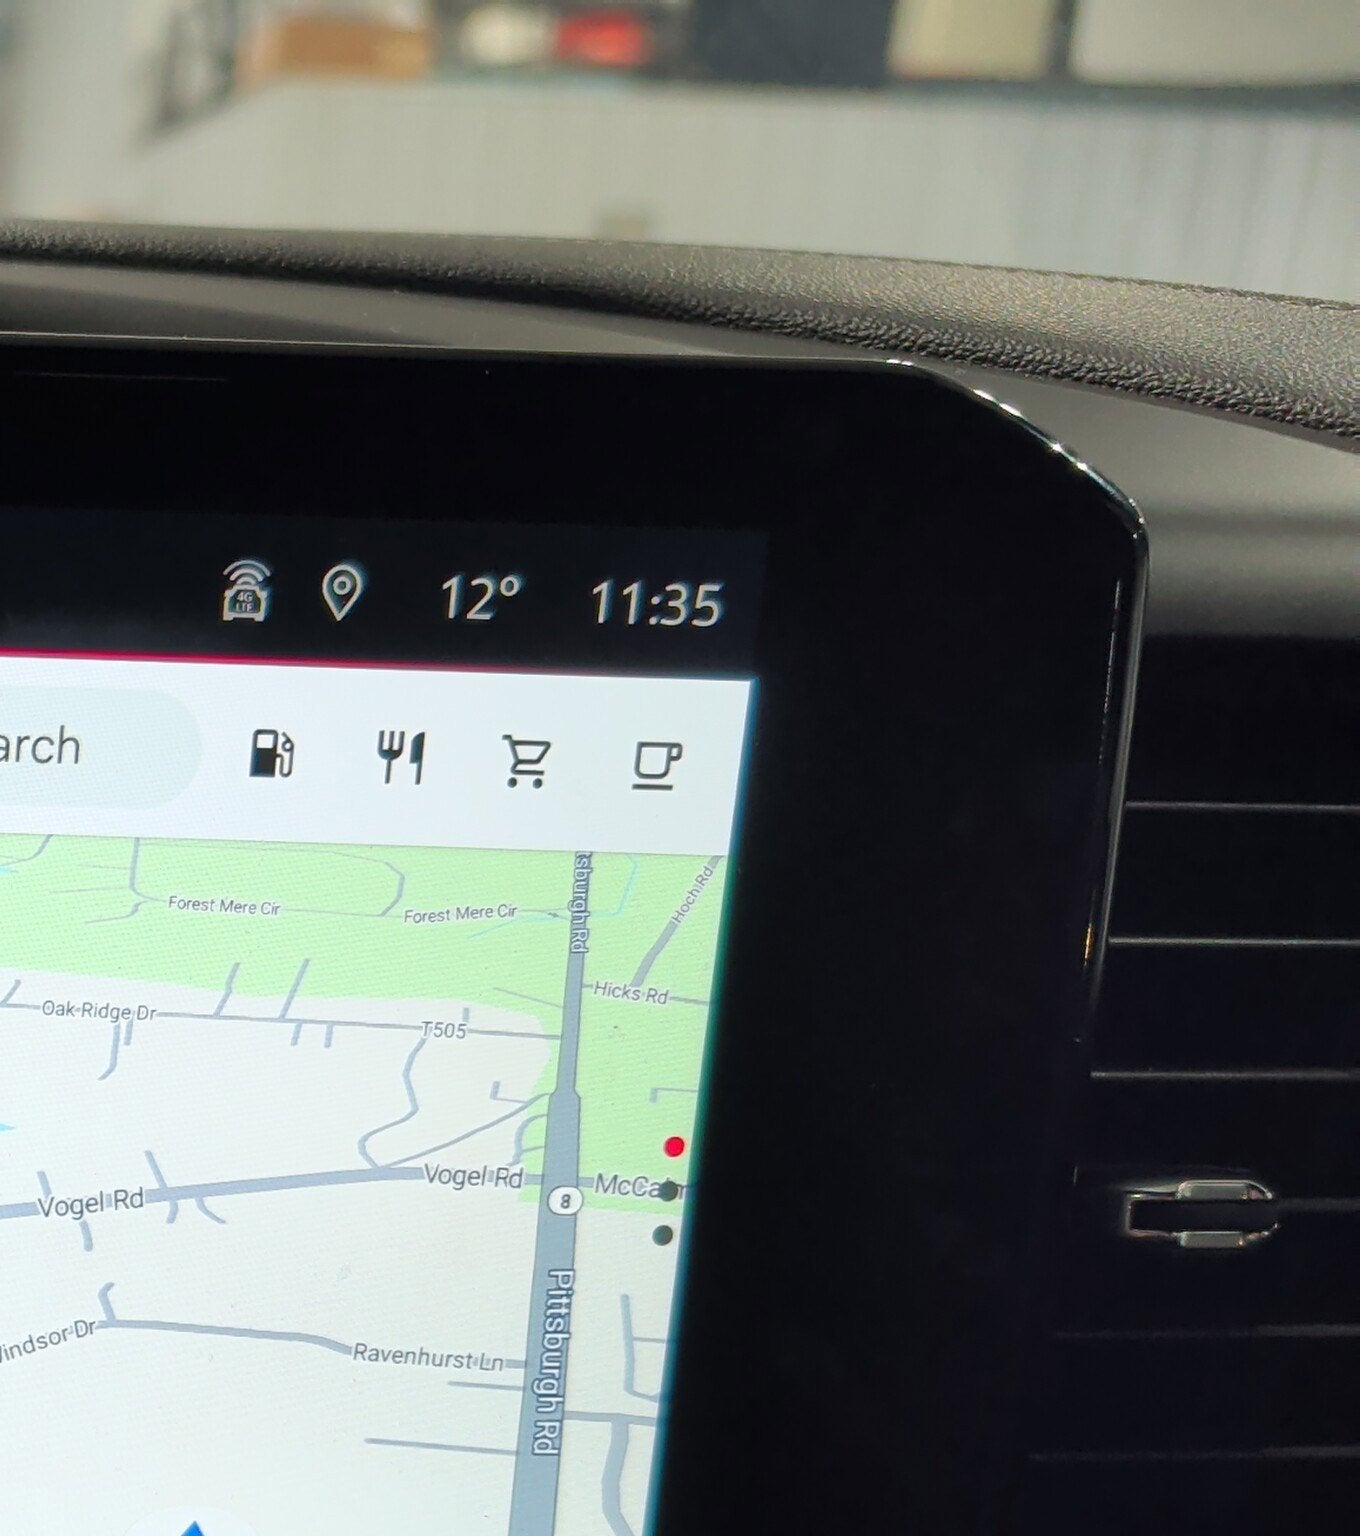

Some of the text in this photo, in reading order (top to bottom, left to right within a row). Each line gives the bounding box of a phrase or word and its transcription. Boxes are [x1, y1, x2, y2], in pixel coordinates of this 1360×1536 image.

[236, 602, 255, 612] LTE
[237, 591, 254, 602] 4G
[592, 579, 725, 627] 11:35
[168, 896, 281, 916] Forest Mere Cir
[671, 866, 714, 924] Hoch Rd
[404, 904, 518, 924] Forest Mere Cir
[570, 928, 590, 953] Rd
[593, 981, 670, 1005] Hicks Rd
[42, 1000, 157, 1023] Oak Ridge Dr
[422, 1021, 468, 1040] T505
[424, 1163, 524, 1190] Vogel Rd
[38, 1188, 145, 1220] Vogel Rd
[560, 1193, 572, 1209] 8
[74, 1318, 97, 1339] Dr
[352, 1342, 505, 1372] Ravenhurst Ln
[532, 1268, 575, 1457] Pittsburgh Rd
